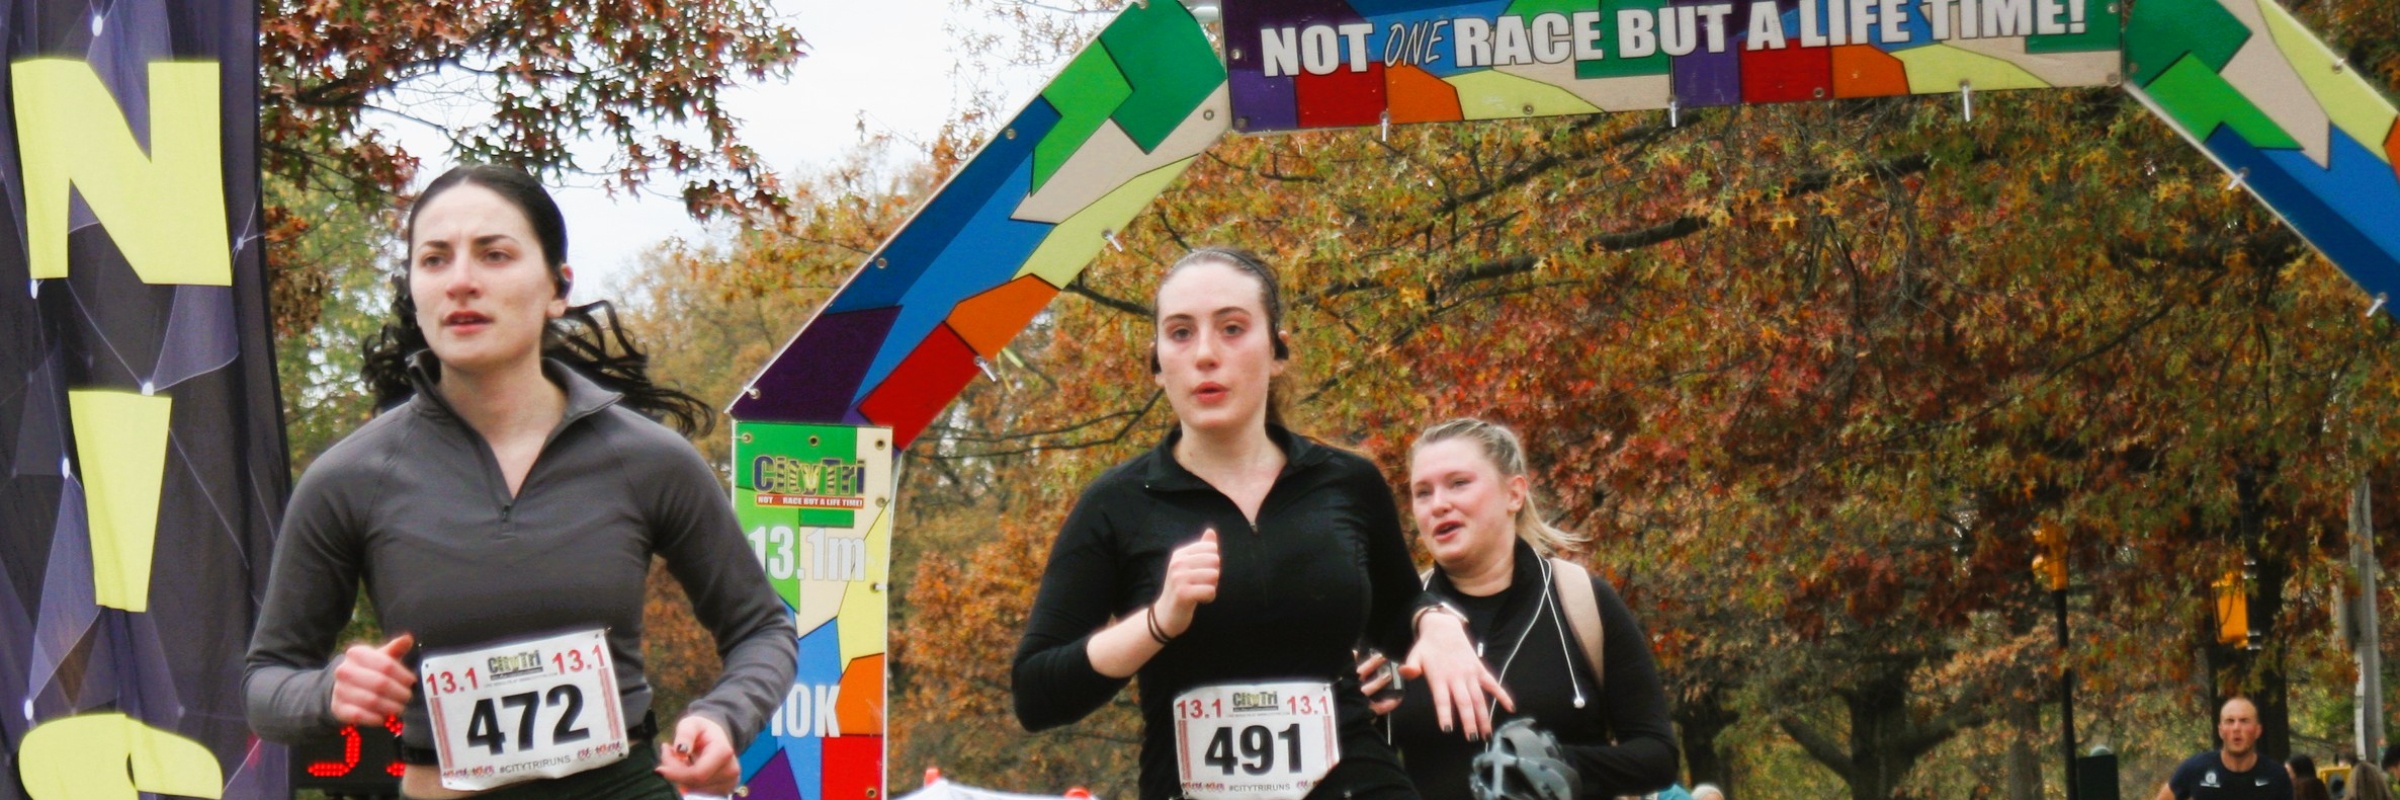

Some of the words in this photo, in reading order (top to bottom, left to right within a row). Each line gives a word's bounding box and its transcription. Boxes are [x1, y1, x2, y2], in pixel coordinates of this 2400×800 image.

[1261, 23, 1374, 77] NOT
[1384, 20, 1448, 68] ONE
[1454, 11, 1604, 68] RACE
[1617, 4, 1732, 59] BUT
[1746, 0, 1787, 51] A
[1800, 0, 1911, 47] LIFE
[1920, 0, 2087, 41] TIME!
[754, 456, 865, 495] CityTri
[487, 649, 542, 674] CityTri
[552, 644, 605, 675] 13.1
[427, 667, 479, 696] 13.1
[1176, 698, 1223, 719] 13.1
[1232, 690, 1278, 708] CityTri
[1287, 695, 1329, 716] 13.1
[466, 684, 591, 756] 472
[1204, 723, 1303, 776] 491
[500, 754, 571, 774] #CITYTRIRUNS
[1229, 783, 1290, 792] #CITYTRIRUNS
